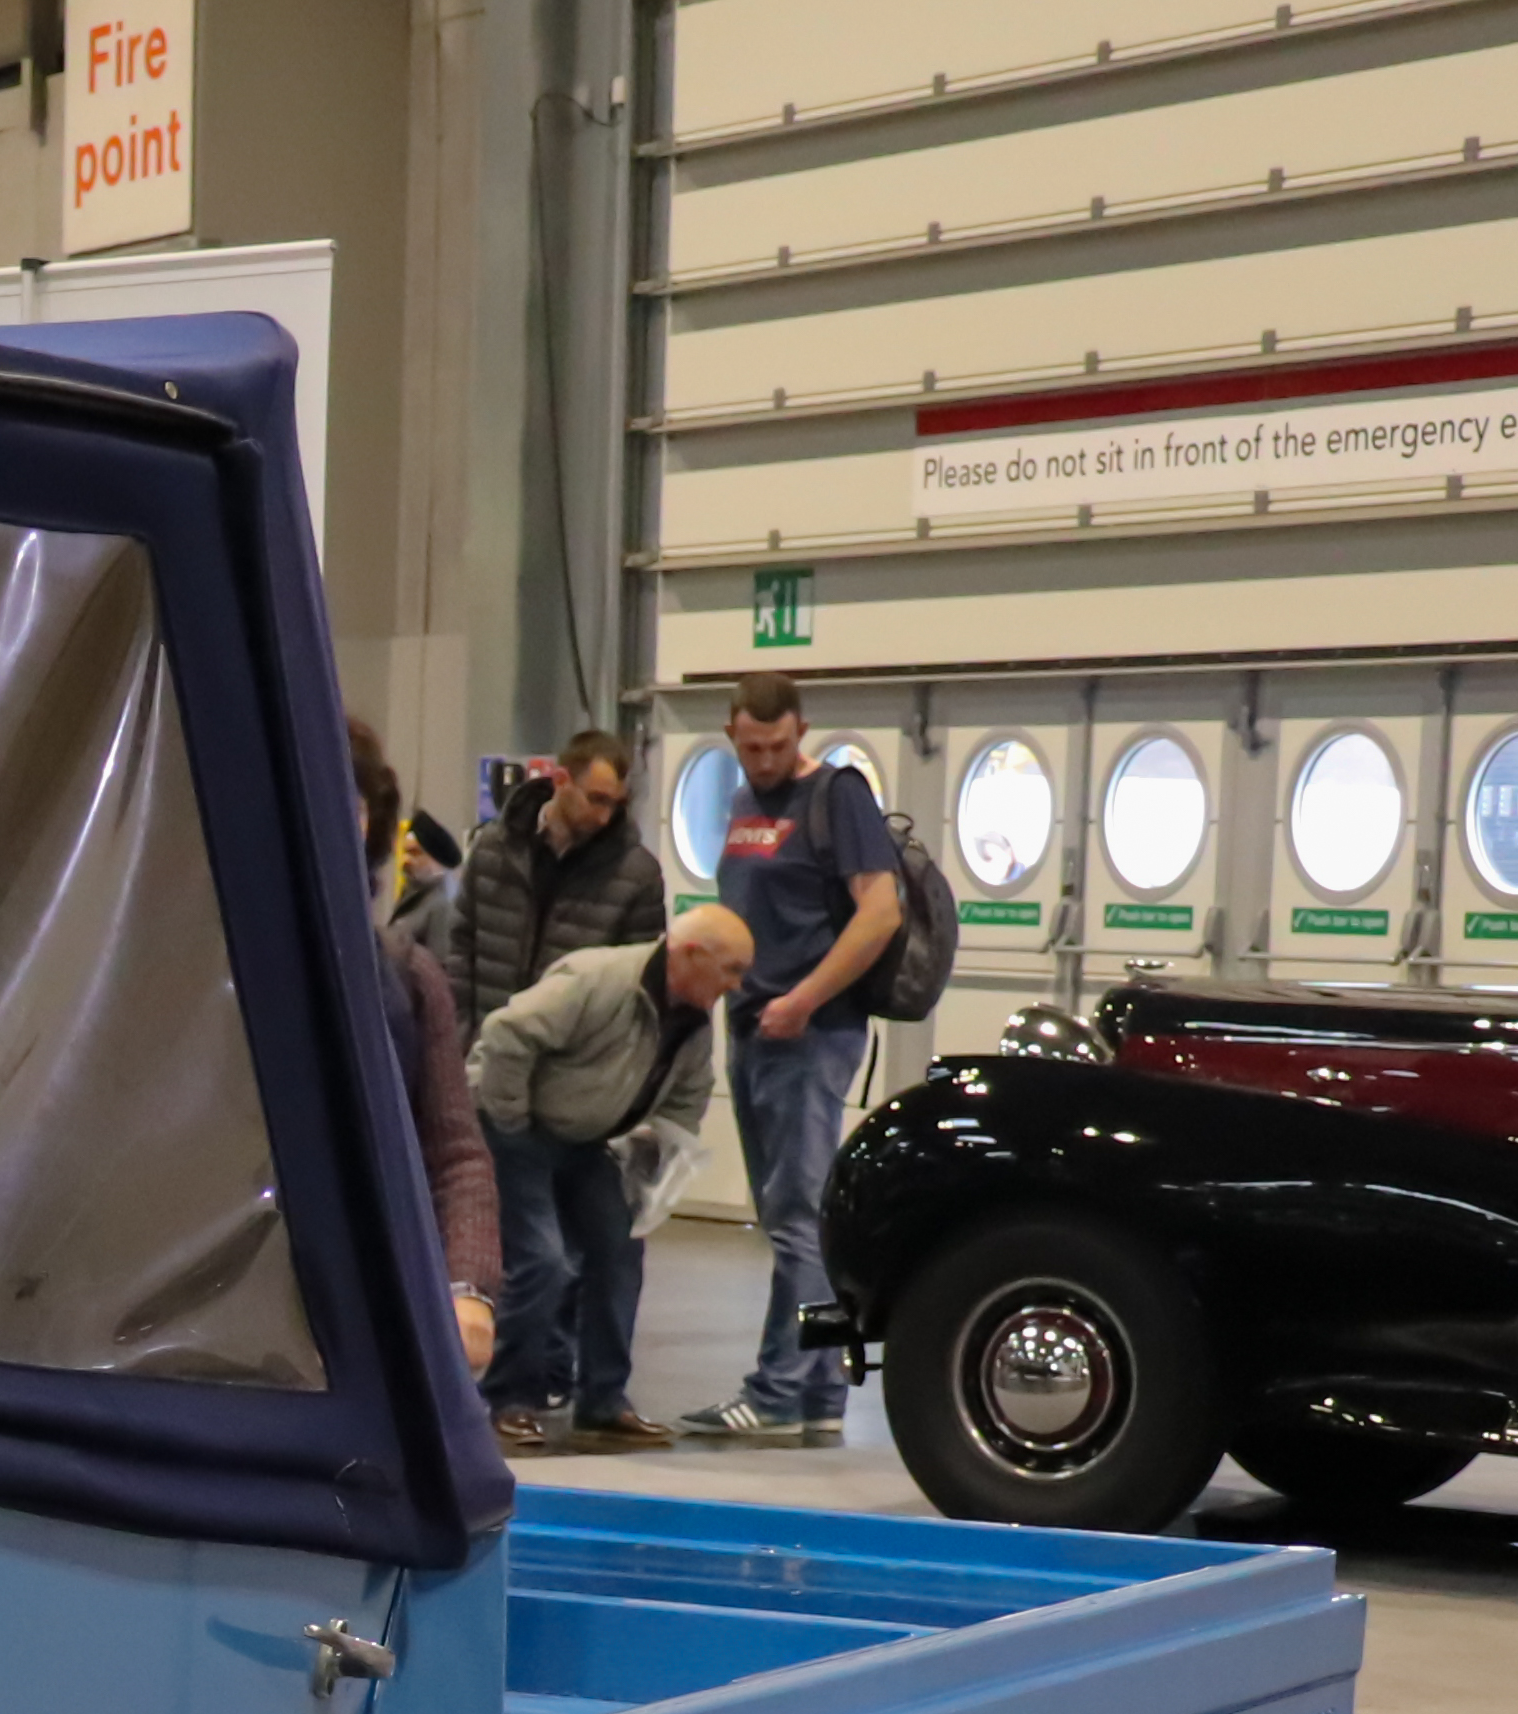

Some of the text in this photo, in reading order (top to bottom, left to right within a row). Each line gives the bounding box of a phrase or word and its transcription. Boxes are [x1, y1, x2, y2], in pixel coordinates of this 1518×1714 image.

[88, 21, 168, 94] Fire
[74, 109, 182, 209] point
[923, 456, 998, 489] Please
[1006, 448, 1037, 482] do
[1046, 448, 1087, 479] not
[1096, 440, 1124, 475] sit
[1133, 438, 1155, 471] in
[1164, 431, 1228, 468] front
[1235, 423, 1265, 462] of
[1271, 421, 1316, 460] the
[1326, 416, 1491, 459] emergency
